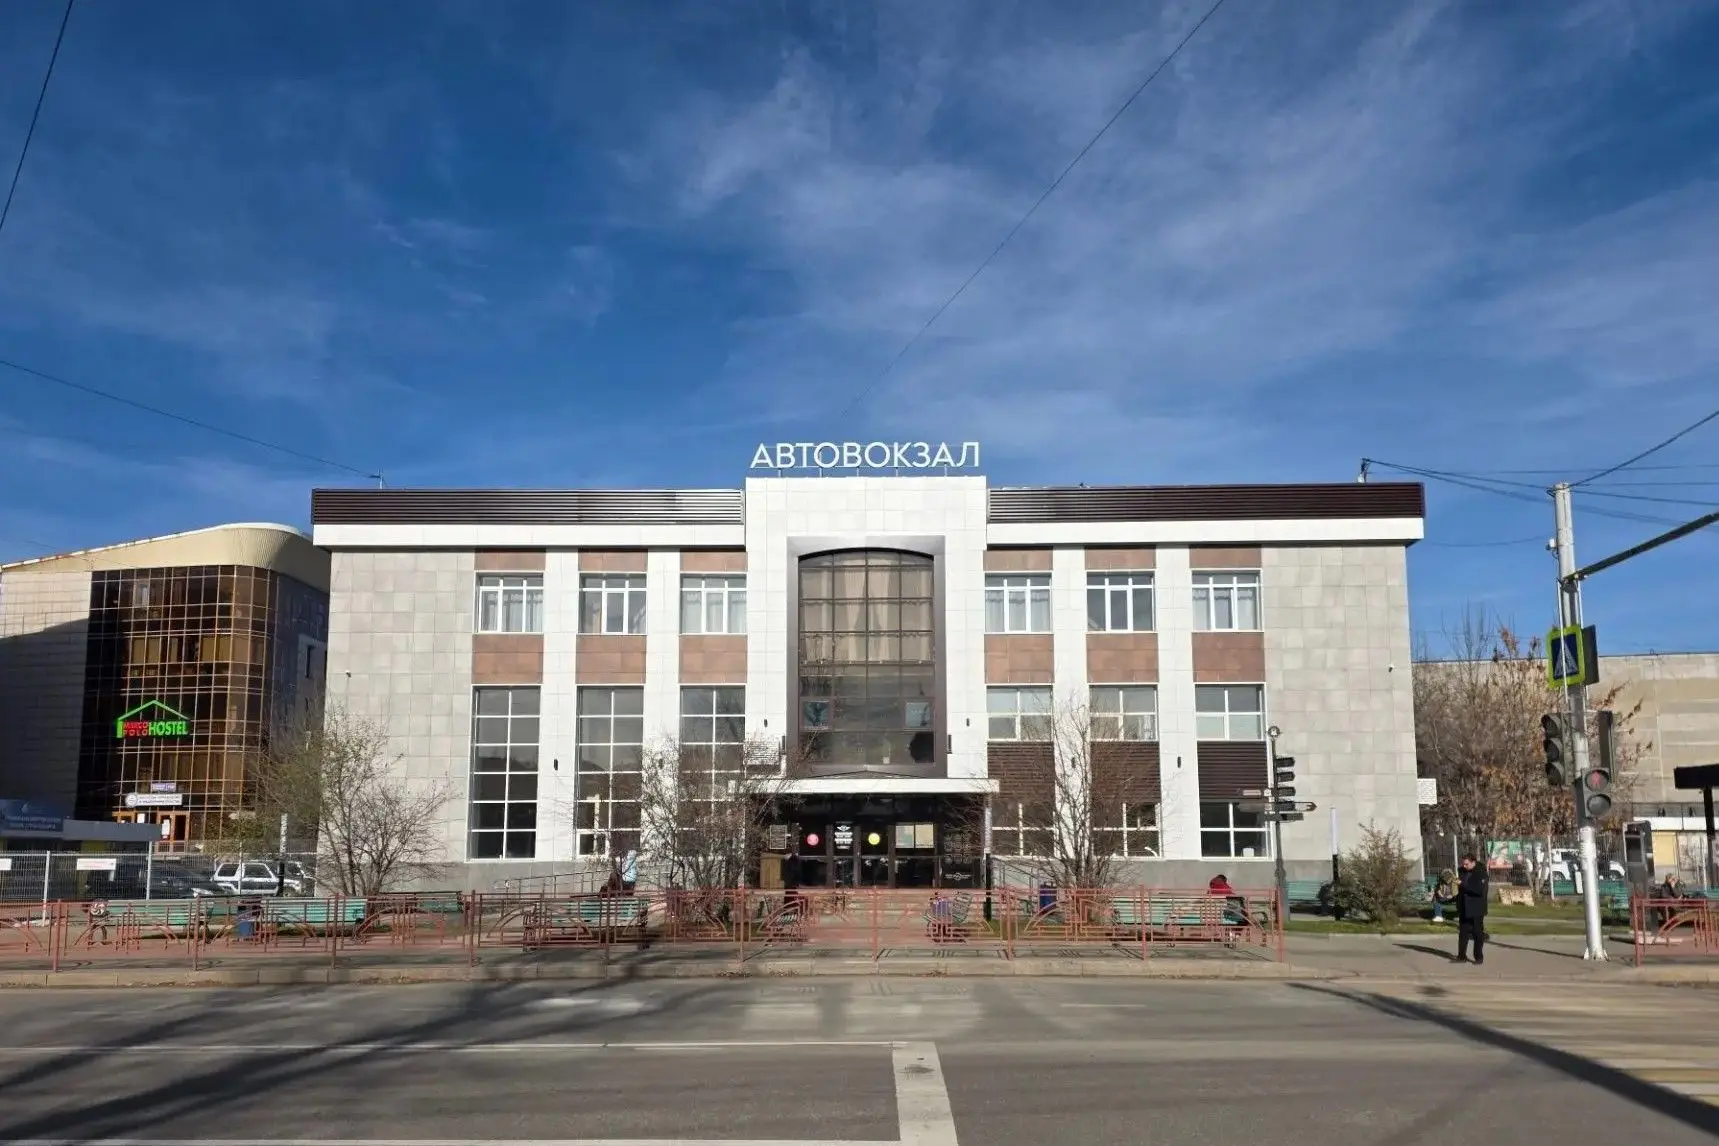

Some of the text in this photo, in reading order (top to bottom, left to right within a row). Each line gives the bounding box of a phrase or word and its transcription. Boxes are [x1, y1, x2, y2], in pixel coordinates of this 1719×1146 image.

[750, 441, 979, 468] АВТОВОКЗАЛ
[123, 729, 148, 737] POLO
[148, 721, 188, 736] HOSTEL
